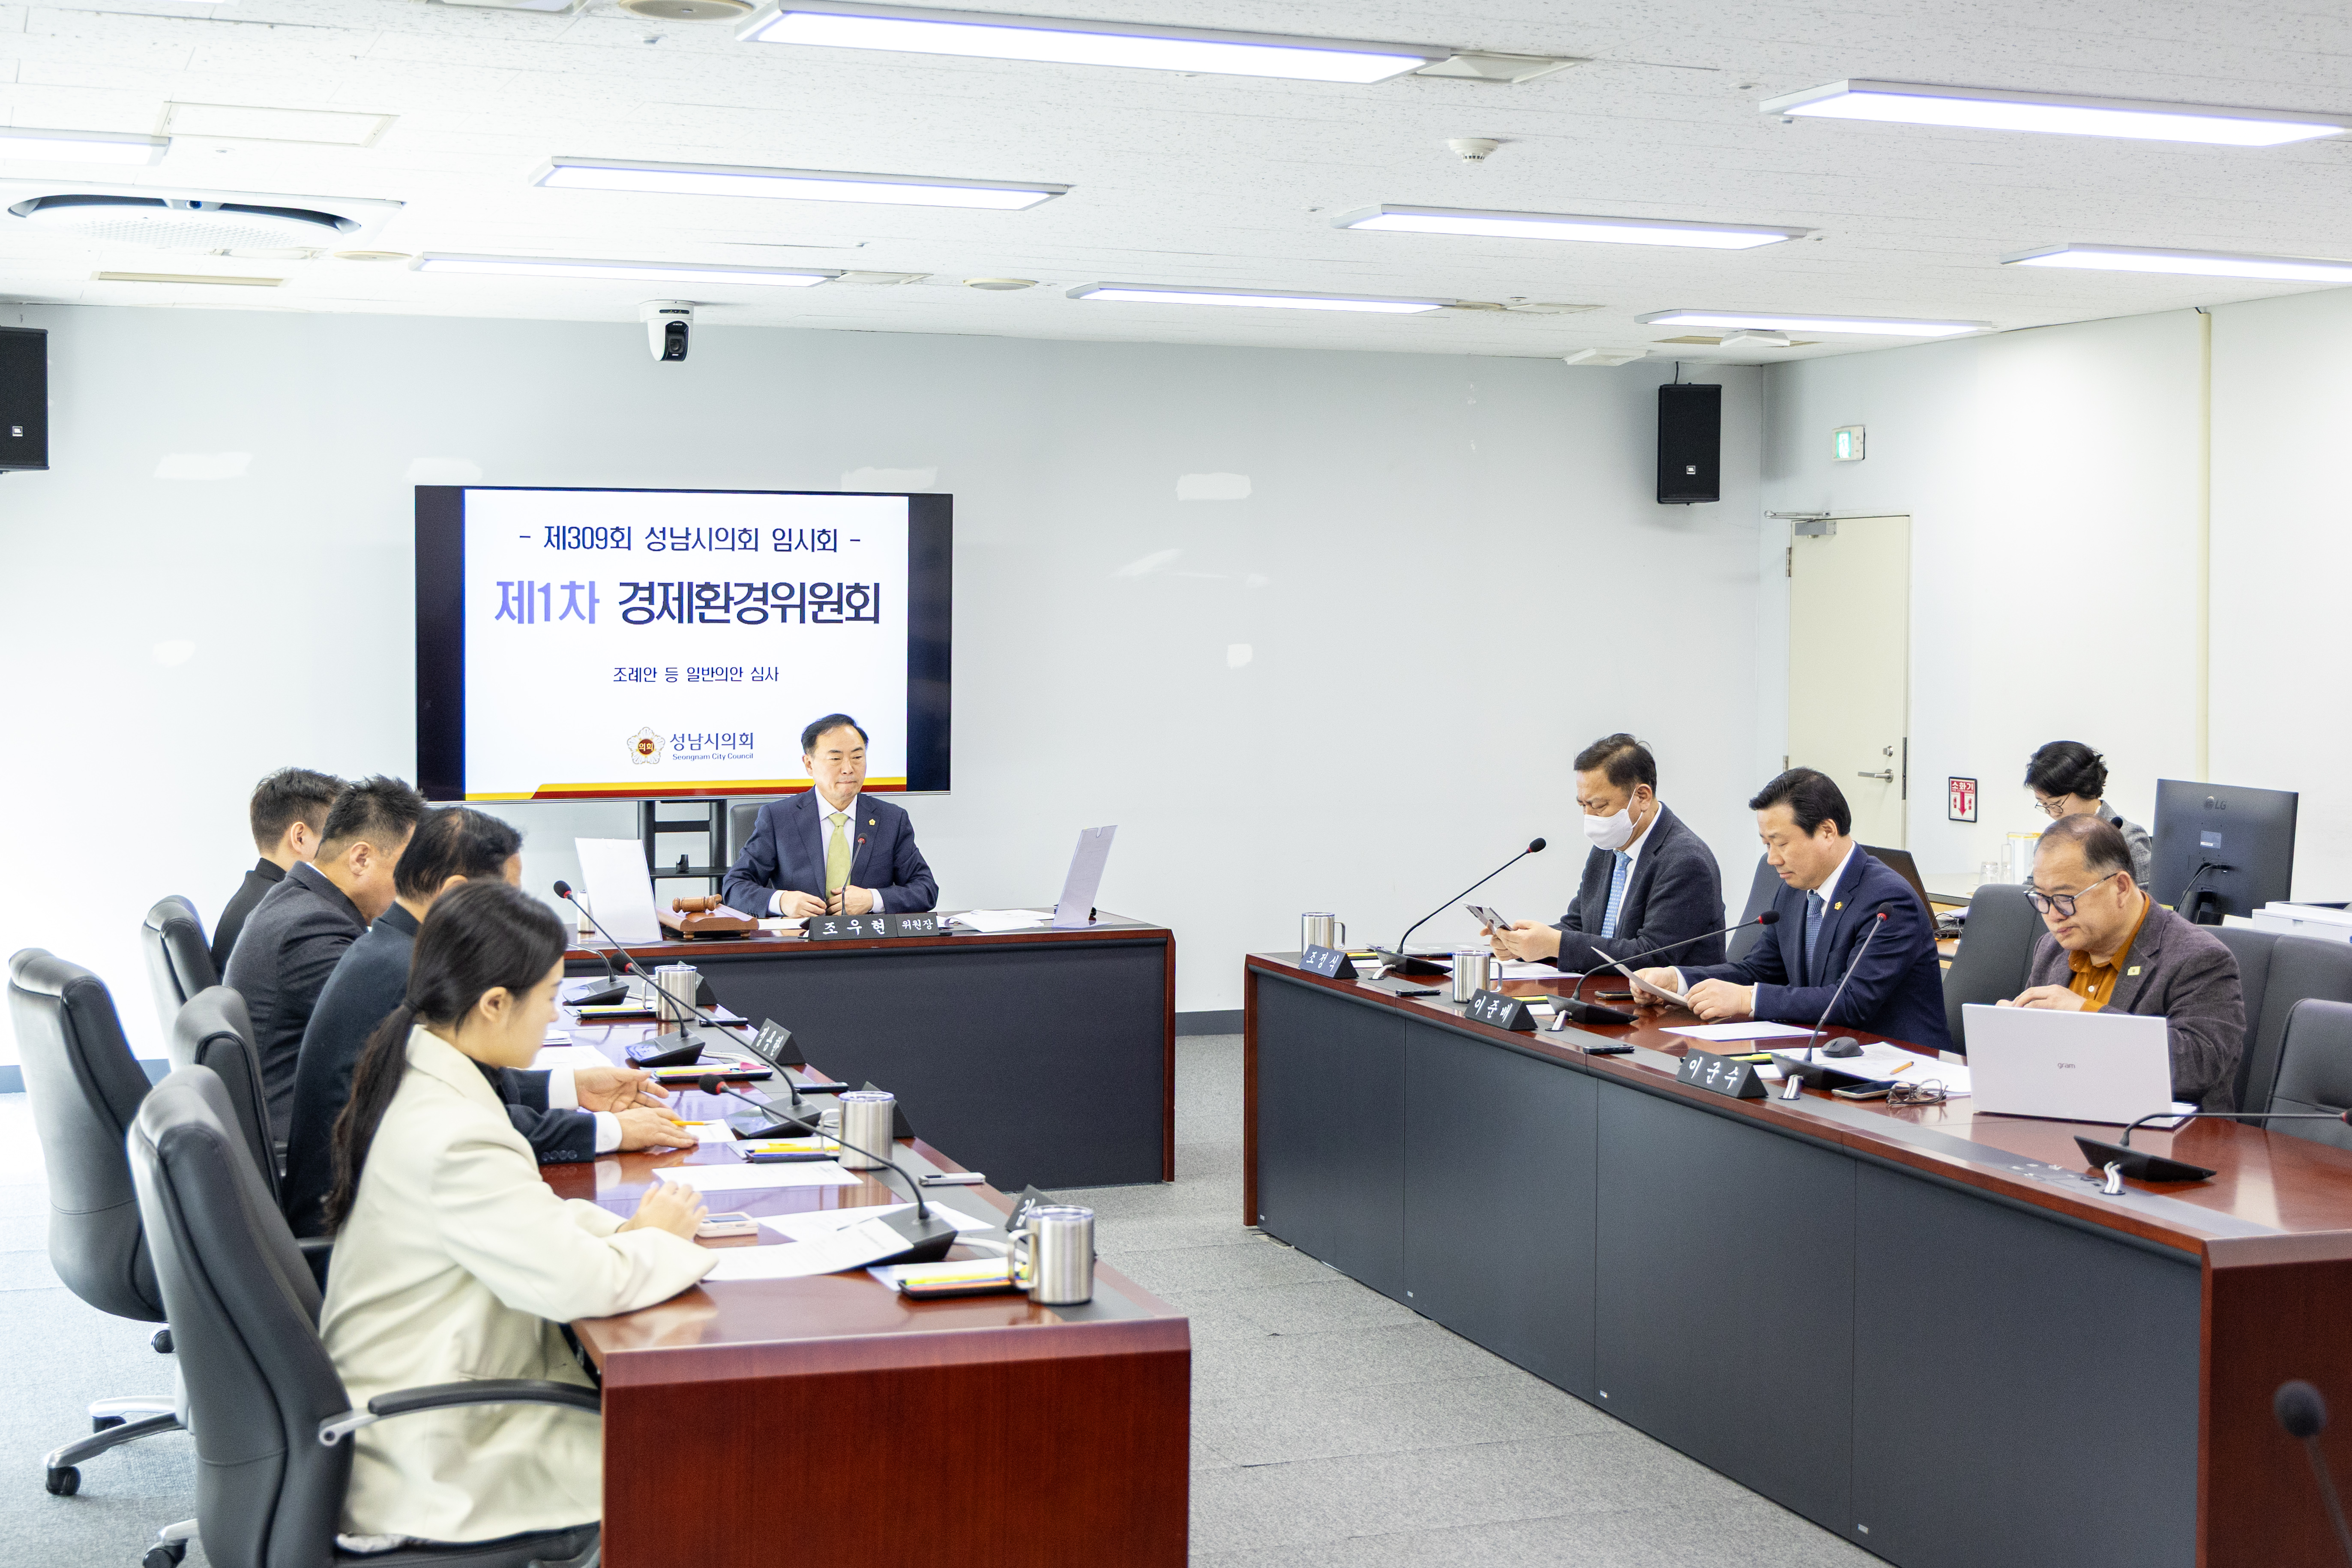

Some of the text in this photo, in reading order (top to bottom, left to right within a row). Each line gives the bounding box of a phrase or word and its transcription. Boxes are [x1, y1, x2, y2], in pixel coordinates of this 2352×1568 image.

[543, 525, 631, 551] 제309회
[645, 527, 758, 552] 성남시의회
[772, 528, 837, 553] 임시회
[494, 580, 880, 625] 제1차 경제환경위원회
[613, 666, 779, 683] 조례안 등 일반의안 심사
[638, 742, 654, 752] 의회
[670, 732, 753, 751] 성남시의회
[1952, 782, 1973, 790] 소화기
[822, 918, 933, 935] 조우현 위원장
[1306, 951, 1339, 971] 조정식
[1474, 995, 1513, 1023] 이준배
[1689, 1056, 1738, 1089] 이군수
